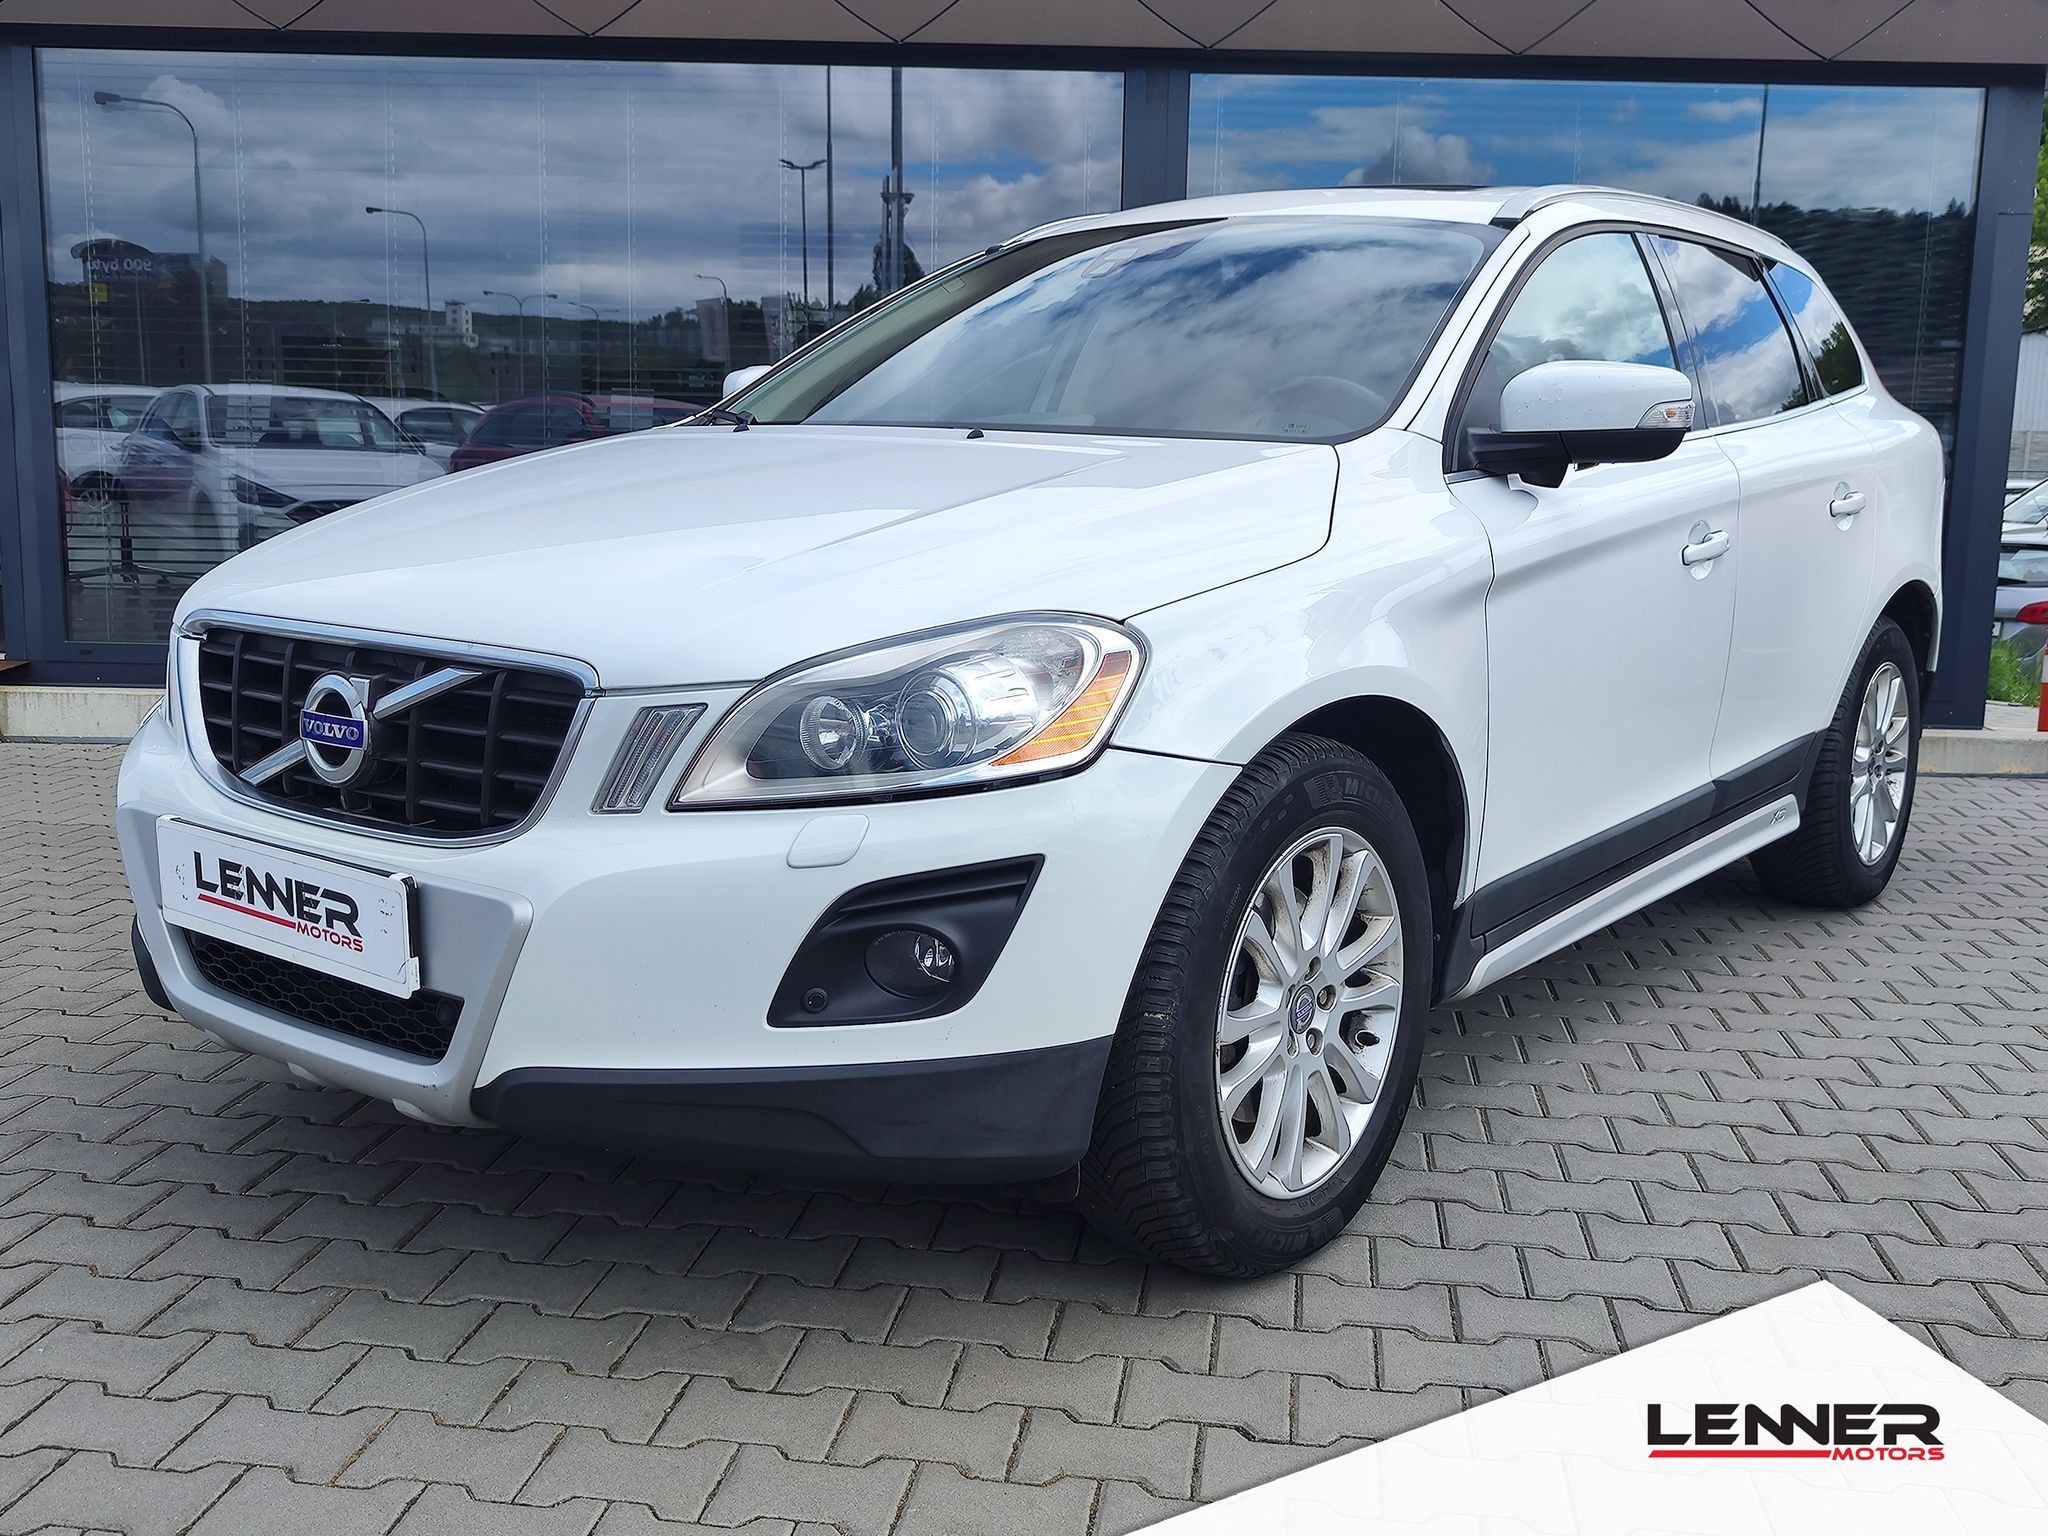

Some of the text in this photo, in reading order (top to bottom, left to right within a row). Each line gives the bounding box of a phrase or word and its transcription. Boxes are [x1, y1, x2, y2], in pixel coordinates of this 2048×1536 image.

[303, 718, 360, 741] VOLVO
[193, 850, 363, 938] LENNER
[296, 920, 364, 953] MOTORS
